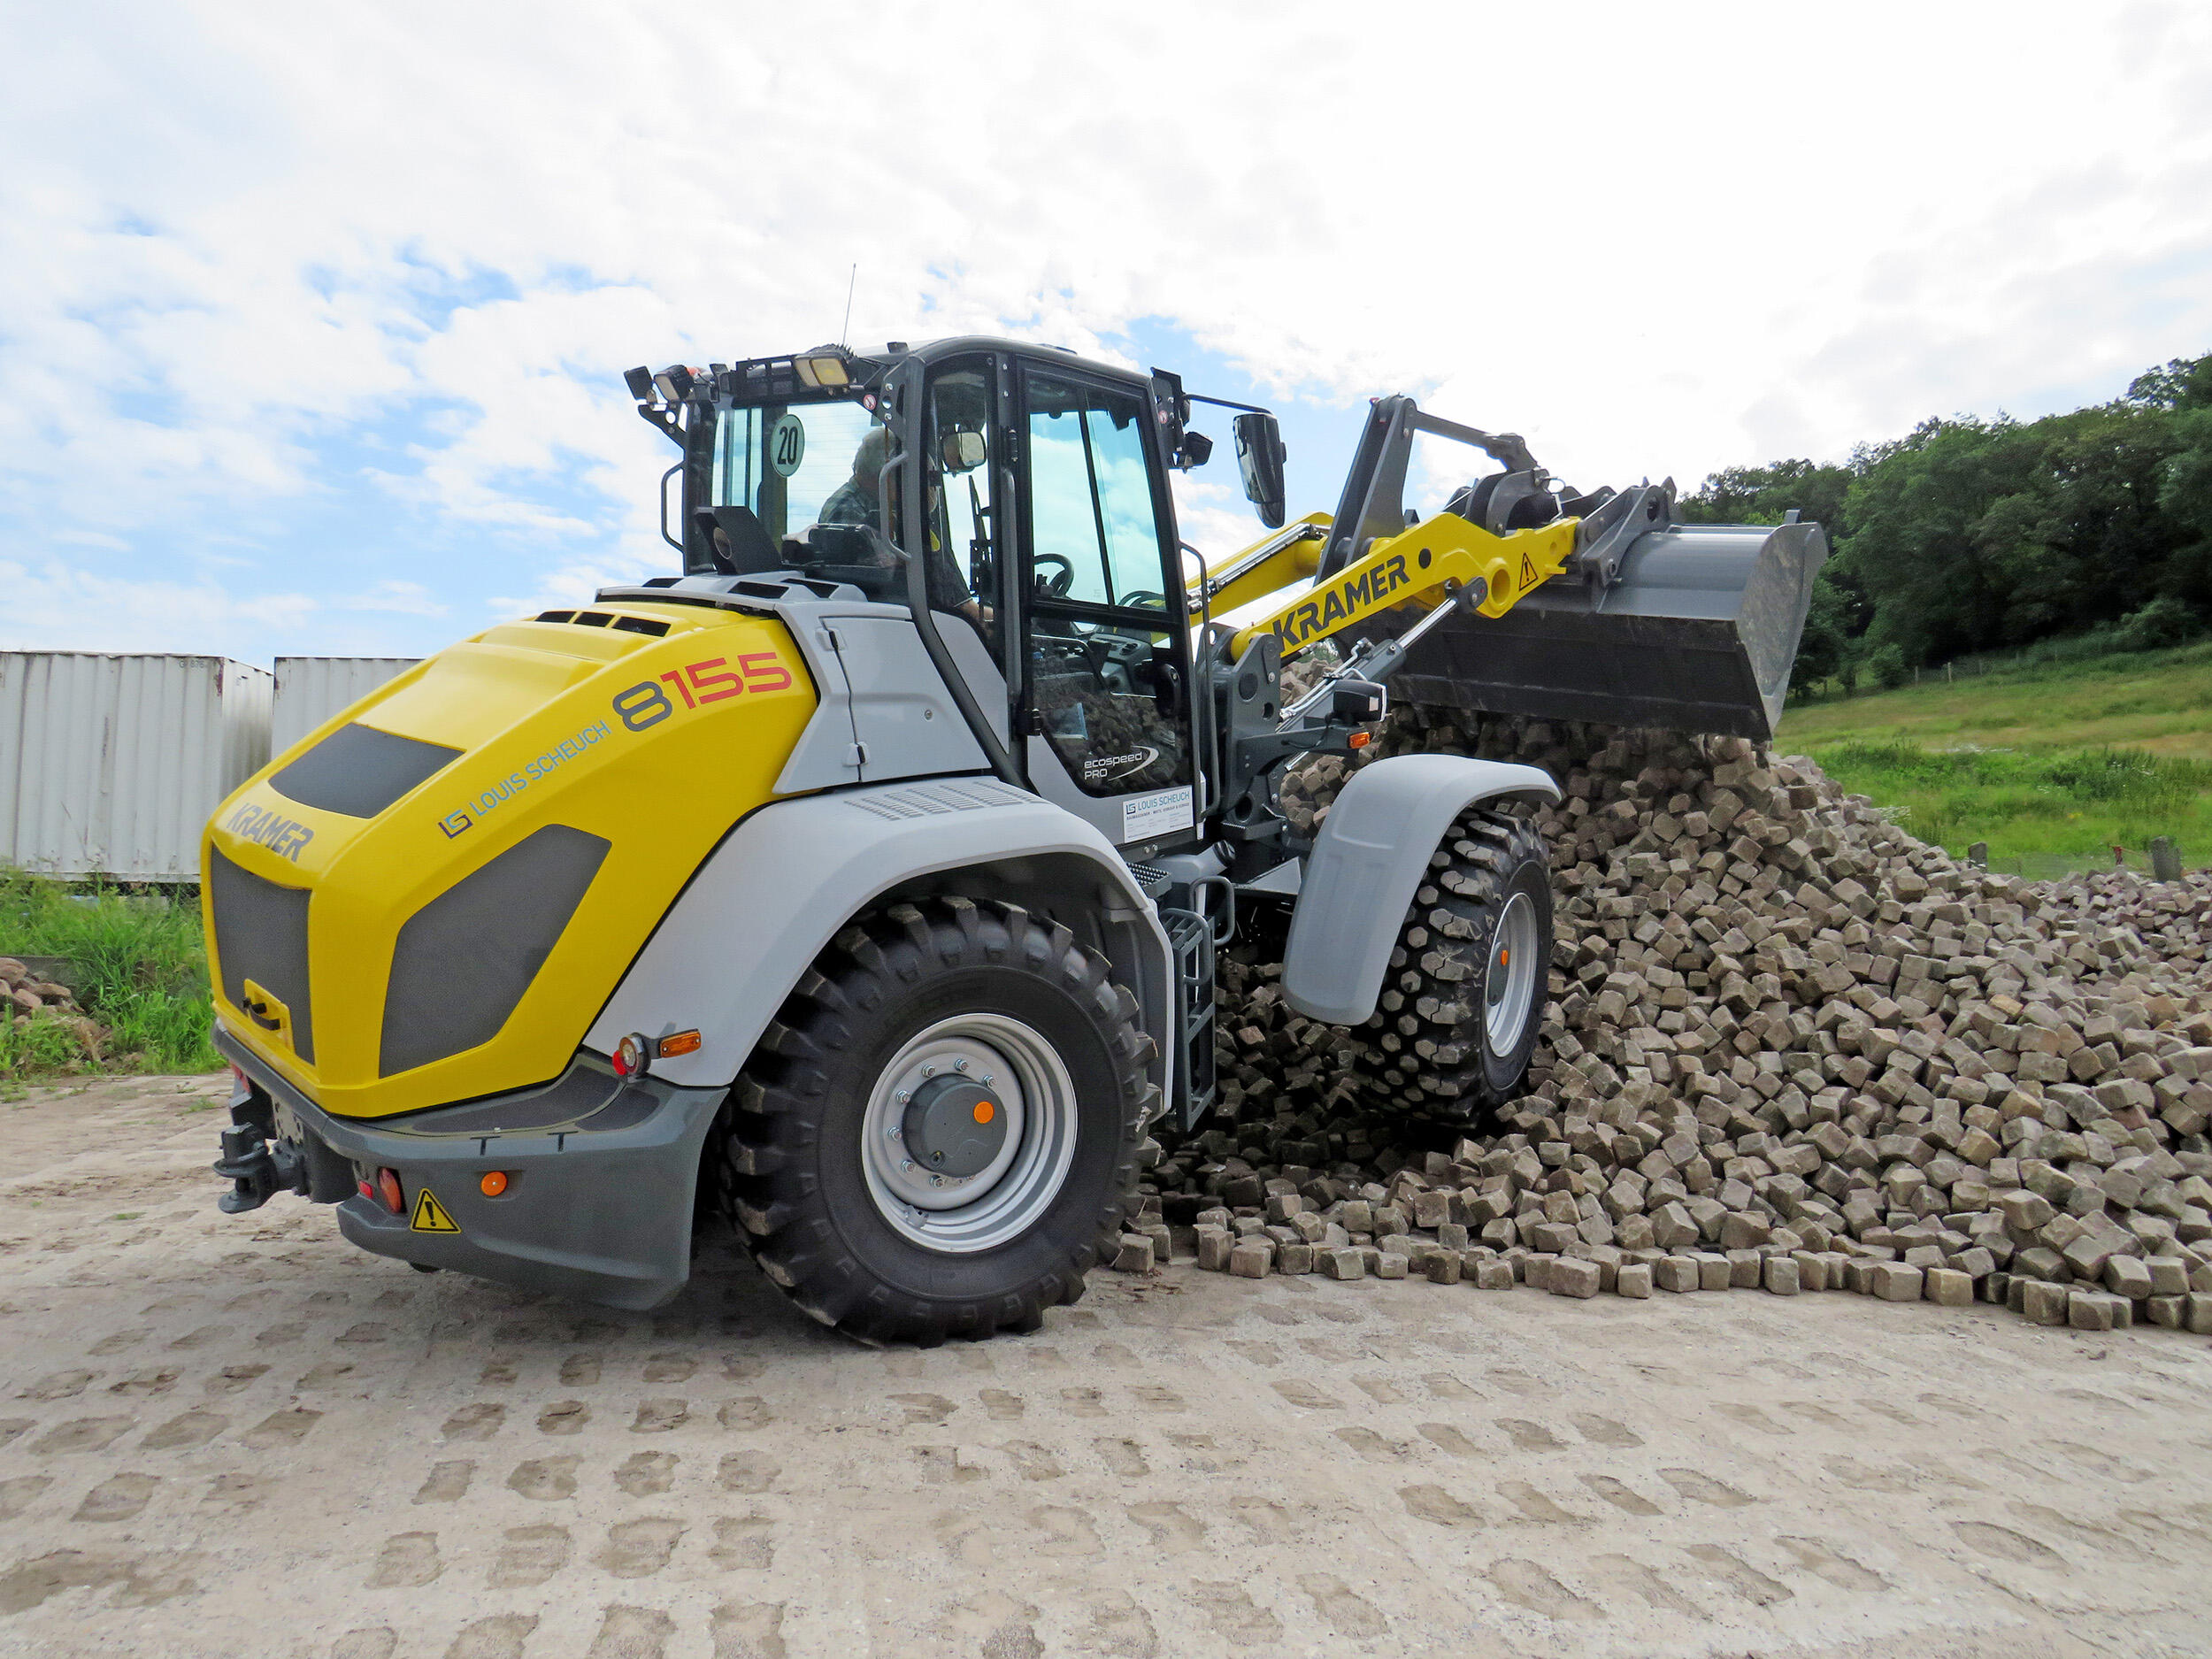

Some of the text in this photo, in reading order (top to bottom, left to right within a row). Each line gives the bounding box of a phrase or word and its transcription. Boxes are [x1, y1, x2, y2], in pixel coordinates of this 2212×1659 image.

[778, 426, 798, 465] 20
[1272, 555, 1410, 651] KRAMER
[612, 652, 793, 733] 8155
[469, 772, 528, 817] LOUIS
[525, 719, 612, 780] SCHEUCH
[1084, 751, 1142, 769] ecospeed
[1084, 768, 1108, 780] PRO
[1138, 798, 1158, 811] LOUIS
[1159, 790, 1190, 807] SCHEUCH
[227, 803, 315, 863] KRAMER
